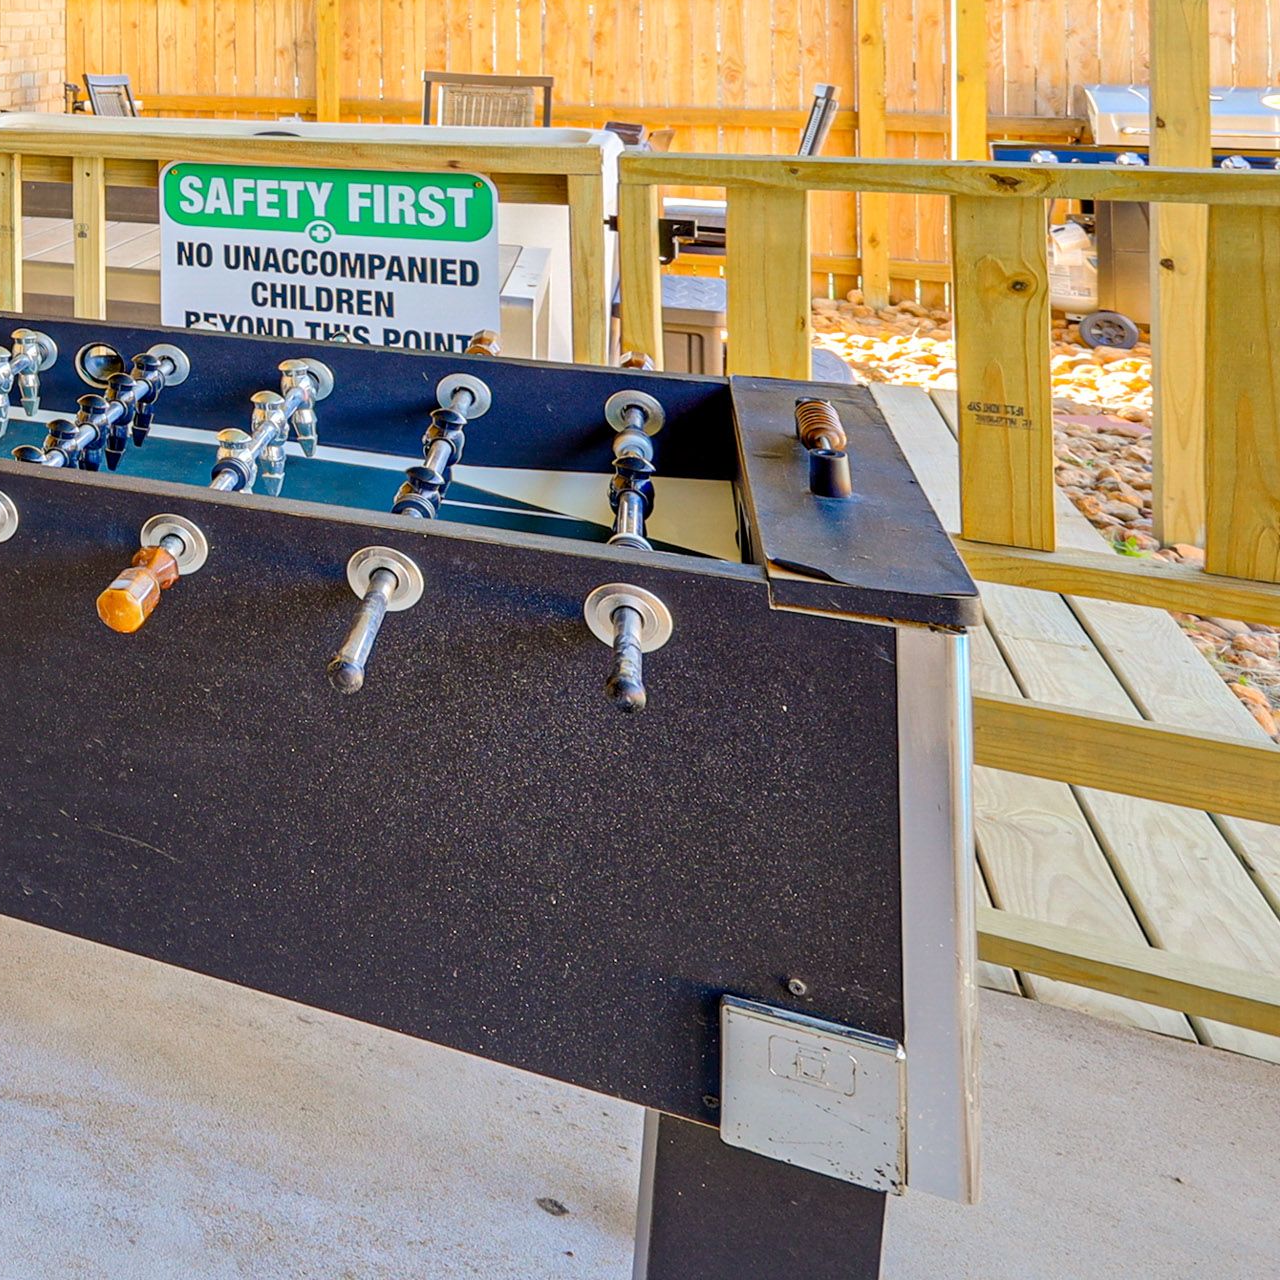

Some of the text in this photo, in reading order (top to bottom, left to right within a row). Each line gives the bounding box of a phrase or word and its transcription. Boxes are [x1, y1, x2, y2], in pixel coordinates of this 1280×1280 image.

[179, 175, 474, 228] SAFETY FIRST
[176, 241, 480, 287] NO UNACCOMPANIED
[251, 281, 395, 318] CHILDREN
[383, 327, 473, 355] POINT
